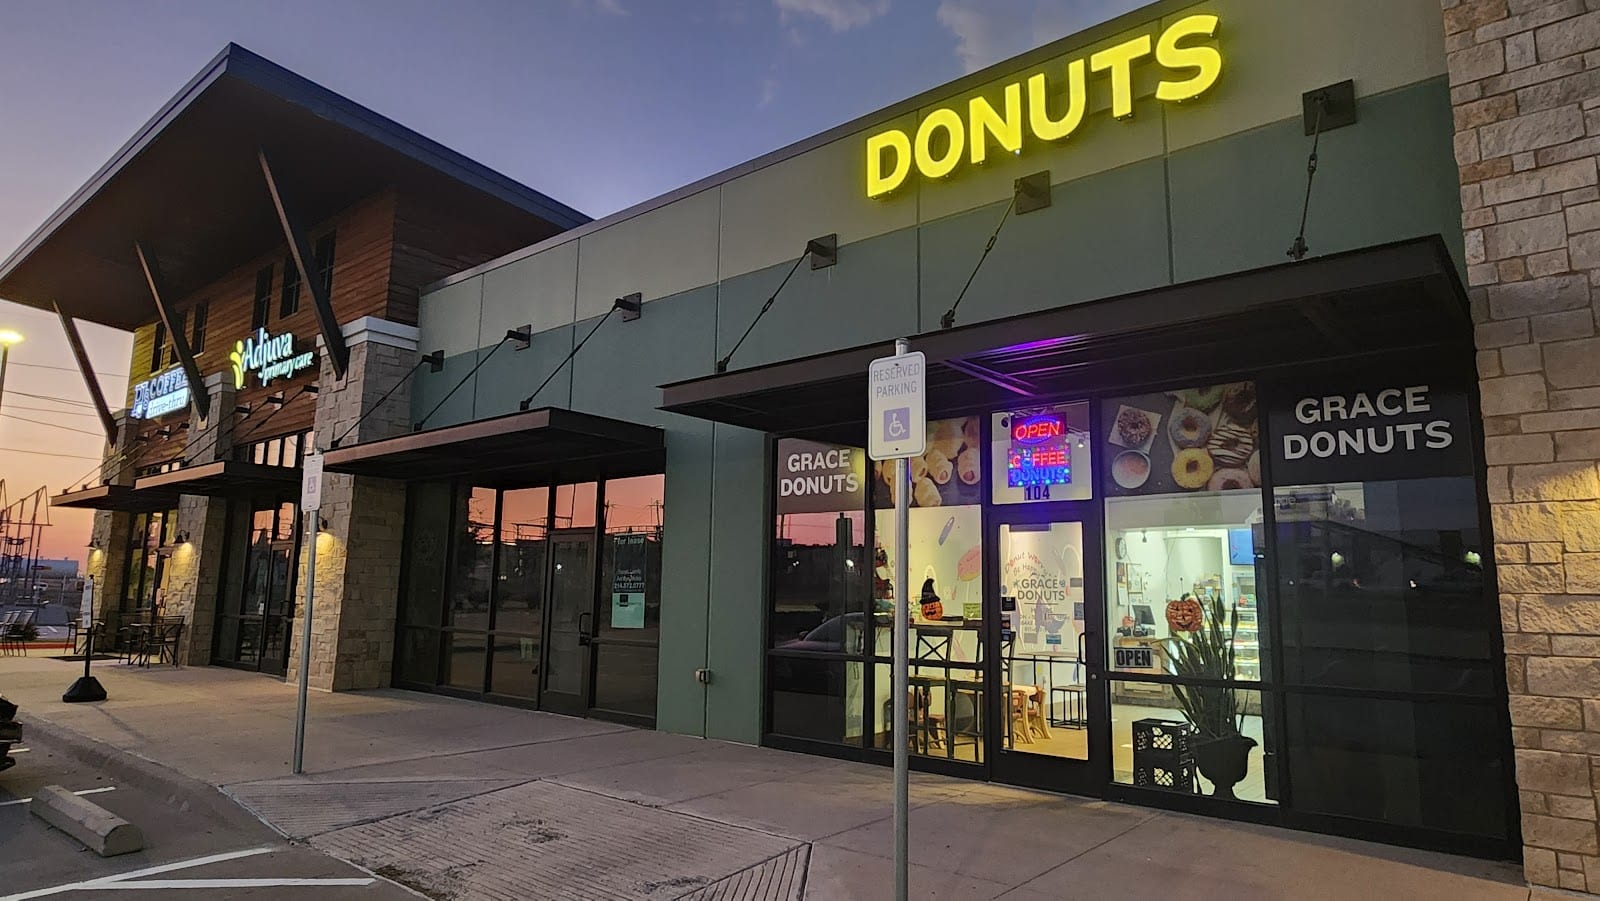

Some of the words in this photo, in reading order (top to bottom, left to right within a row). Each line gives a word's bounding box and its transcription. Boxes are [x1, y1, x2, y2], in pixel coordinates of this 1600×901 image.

[866, 14, 1222, 198] DONUTS
[242, 327, 293, 378] Adjuva
[873, 363, 920, 382] RESERVED
[876, 381, 917, 399] PARKING
[1295, 385, 1431, 425] GRACE
[1015, 421, 1061, 440] OPEN
[1283, 420, 1453, 460] DONUTS
[787, 448, 851, 472] GRACE
[1011, 466, 1064, 482] DONUTS
[780, 472, 859, 497] DONUTS
[1025, 485, 1050, 500] 104
[1021, 578, 1058, 590] GRACE
[1017, 590, 1066, 601] DONUTS
[1116, 650, 1151, 666] OPEN
